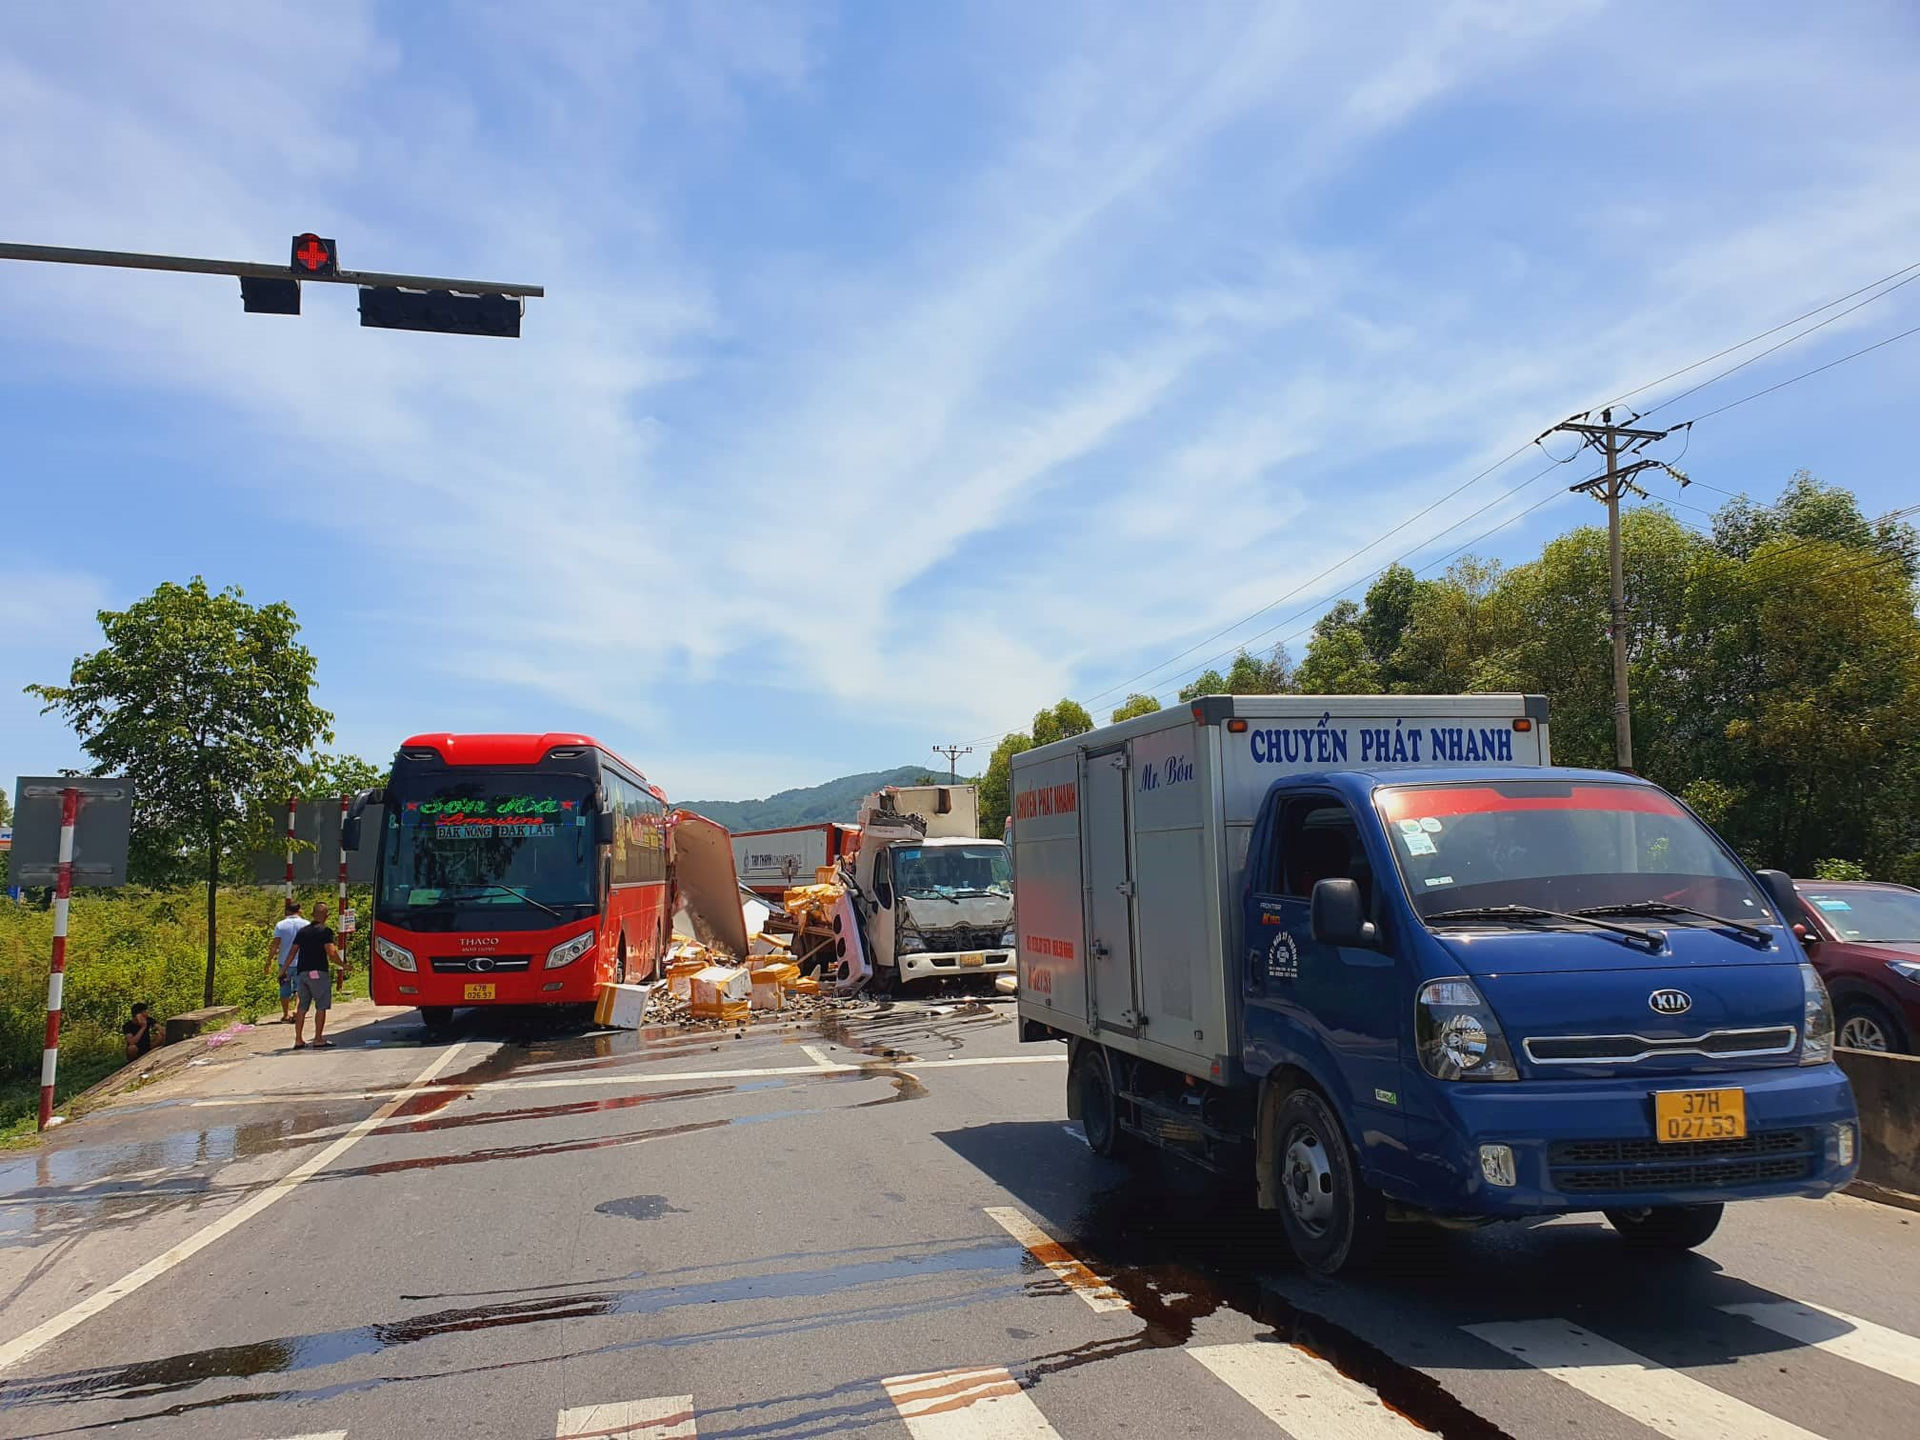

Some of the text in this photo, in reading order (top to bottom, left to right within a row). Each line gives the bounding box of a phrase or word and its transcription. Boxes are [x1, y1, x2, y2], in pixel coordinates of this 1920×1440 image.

[1251, 712, 1513, 763] CHUYỂN PHÁT NHANH
[460, 937, 499, 946] THACO
[1656, 994, 1687, 1009] KIA
[1682, 1092, 1720, 1114] 37H
[1668, 1115, 1736, 1139] 027.53
